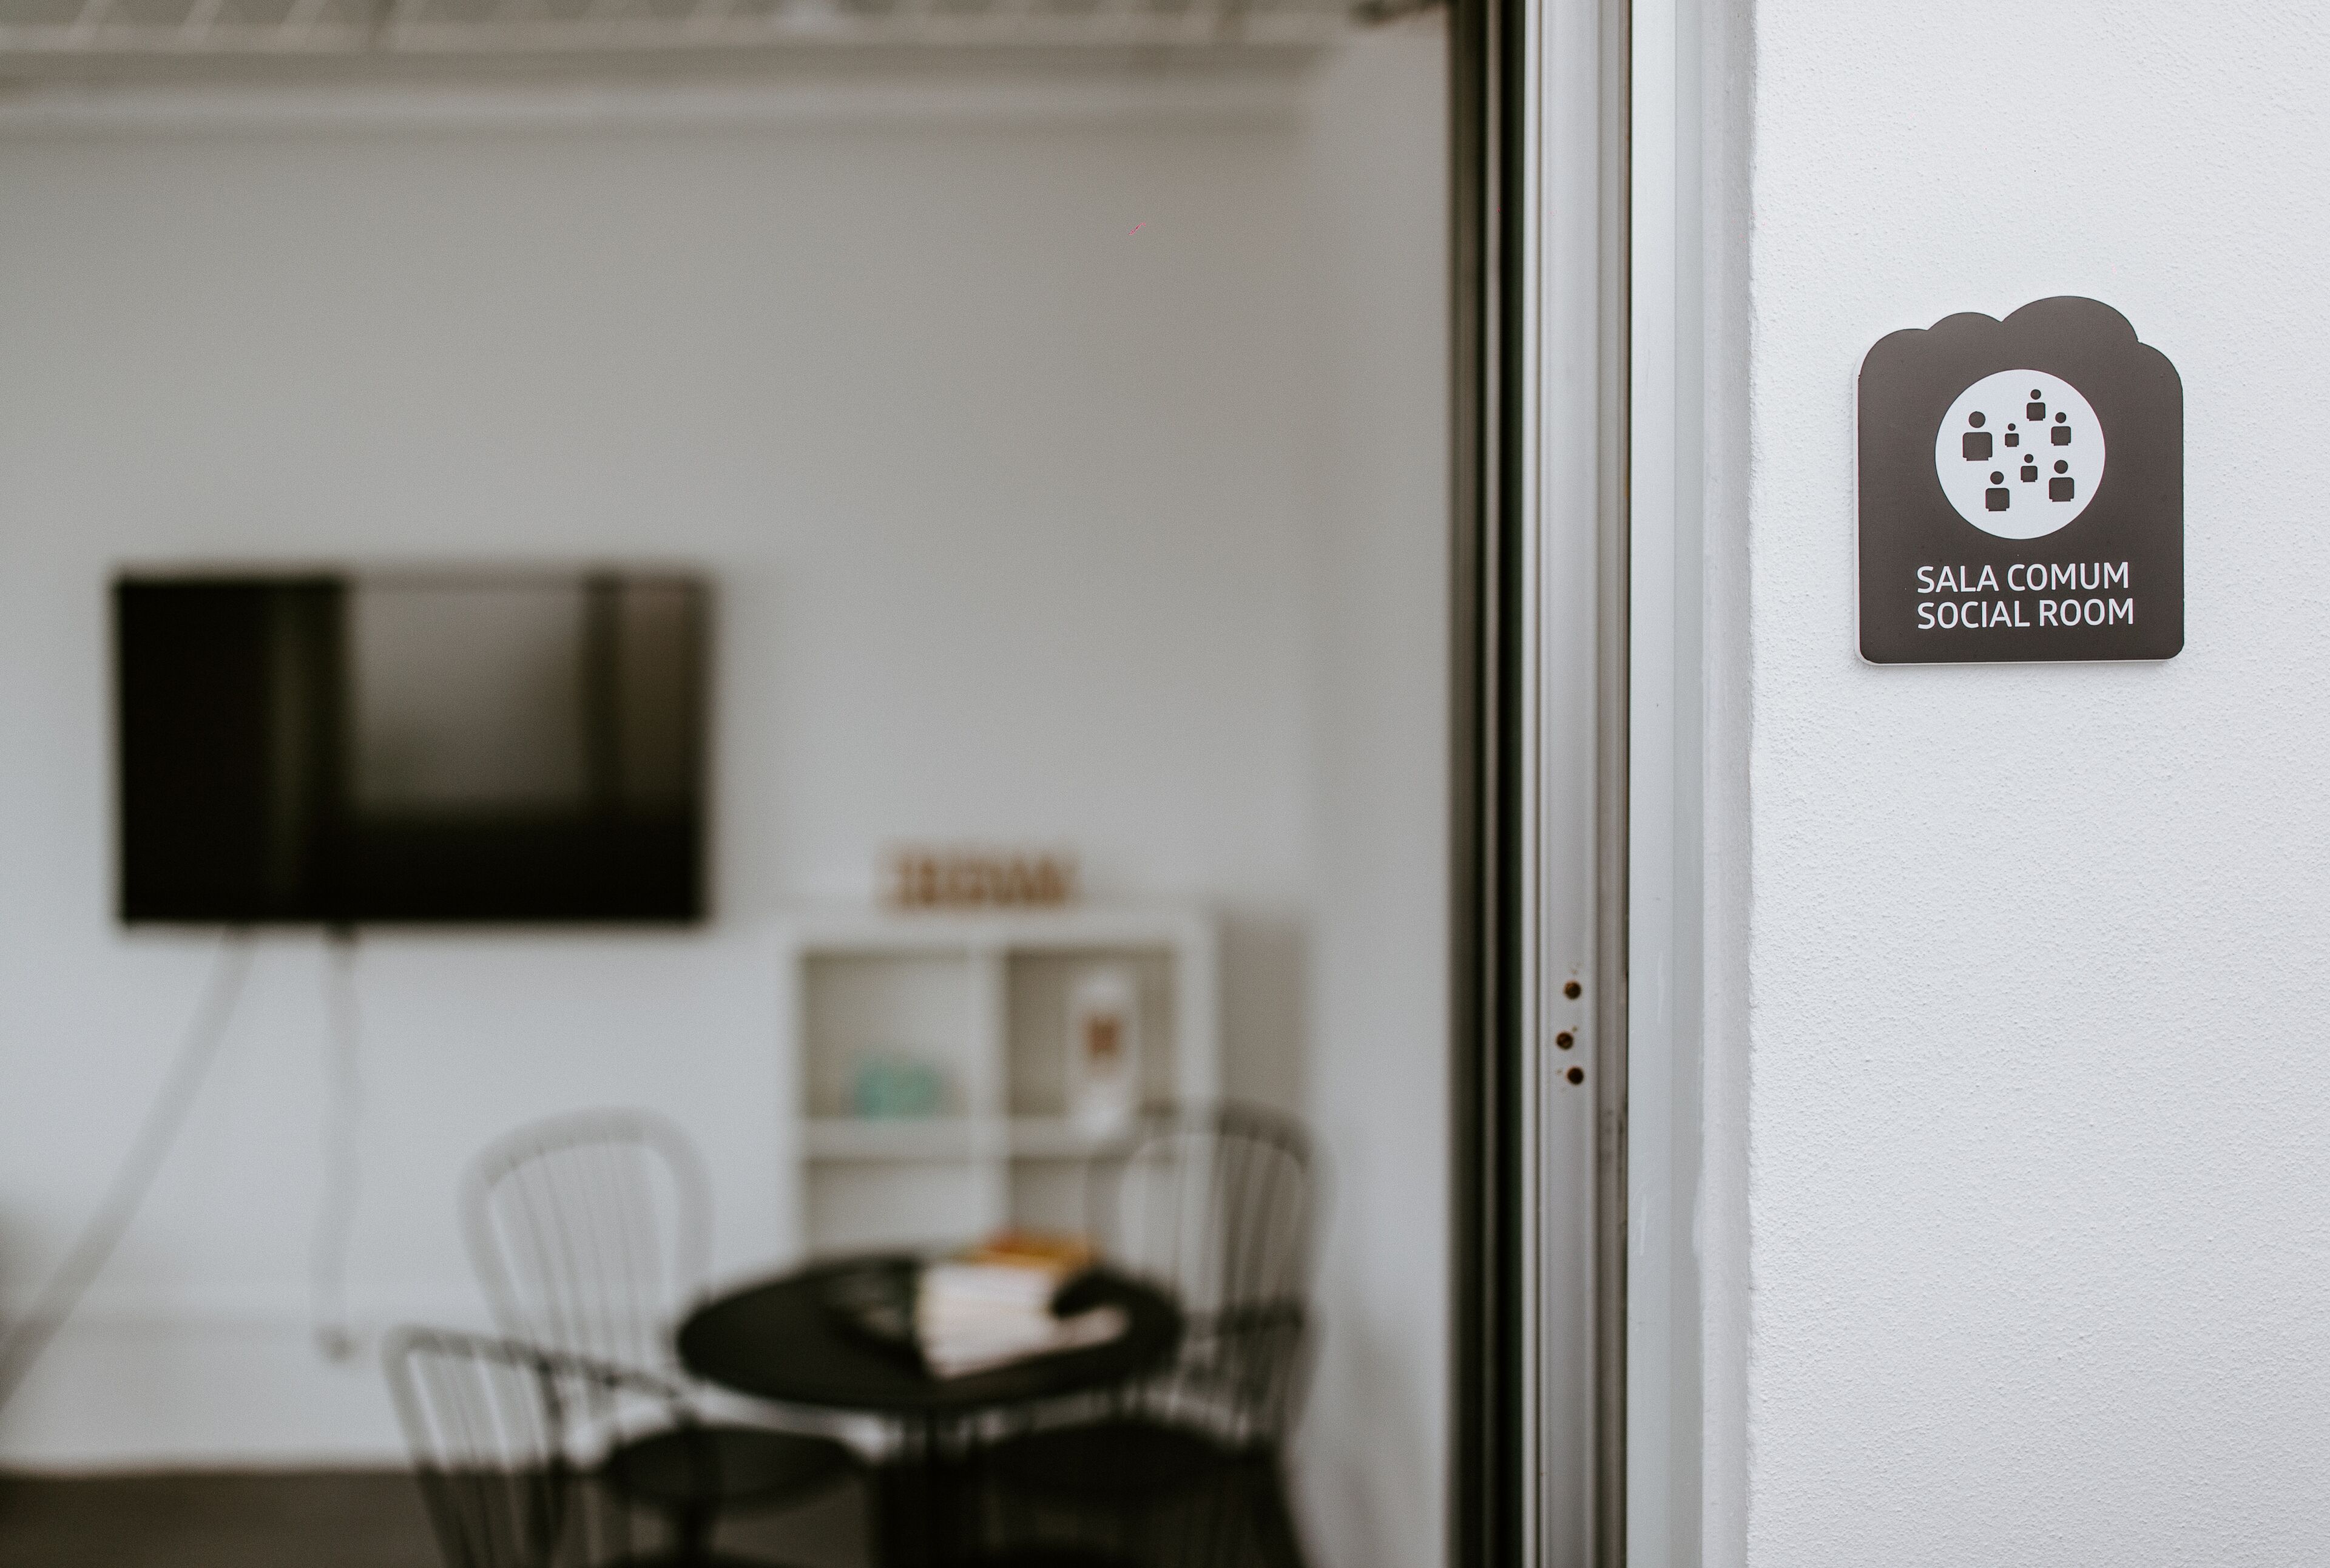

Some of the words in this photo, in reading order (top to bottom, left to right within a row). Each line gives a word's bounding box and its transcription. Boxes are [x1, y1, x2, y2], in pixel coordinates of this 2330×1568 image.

[1917, 565, 1999, 593] SALA
[2007, 561, 2129, 592] COMUM
[1917, 600, 2030, 630] SOCIAL
[2039, 598, 2133, 627] ROOM
